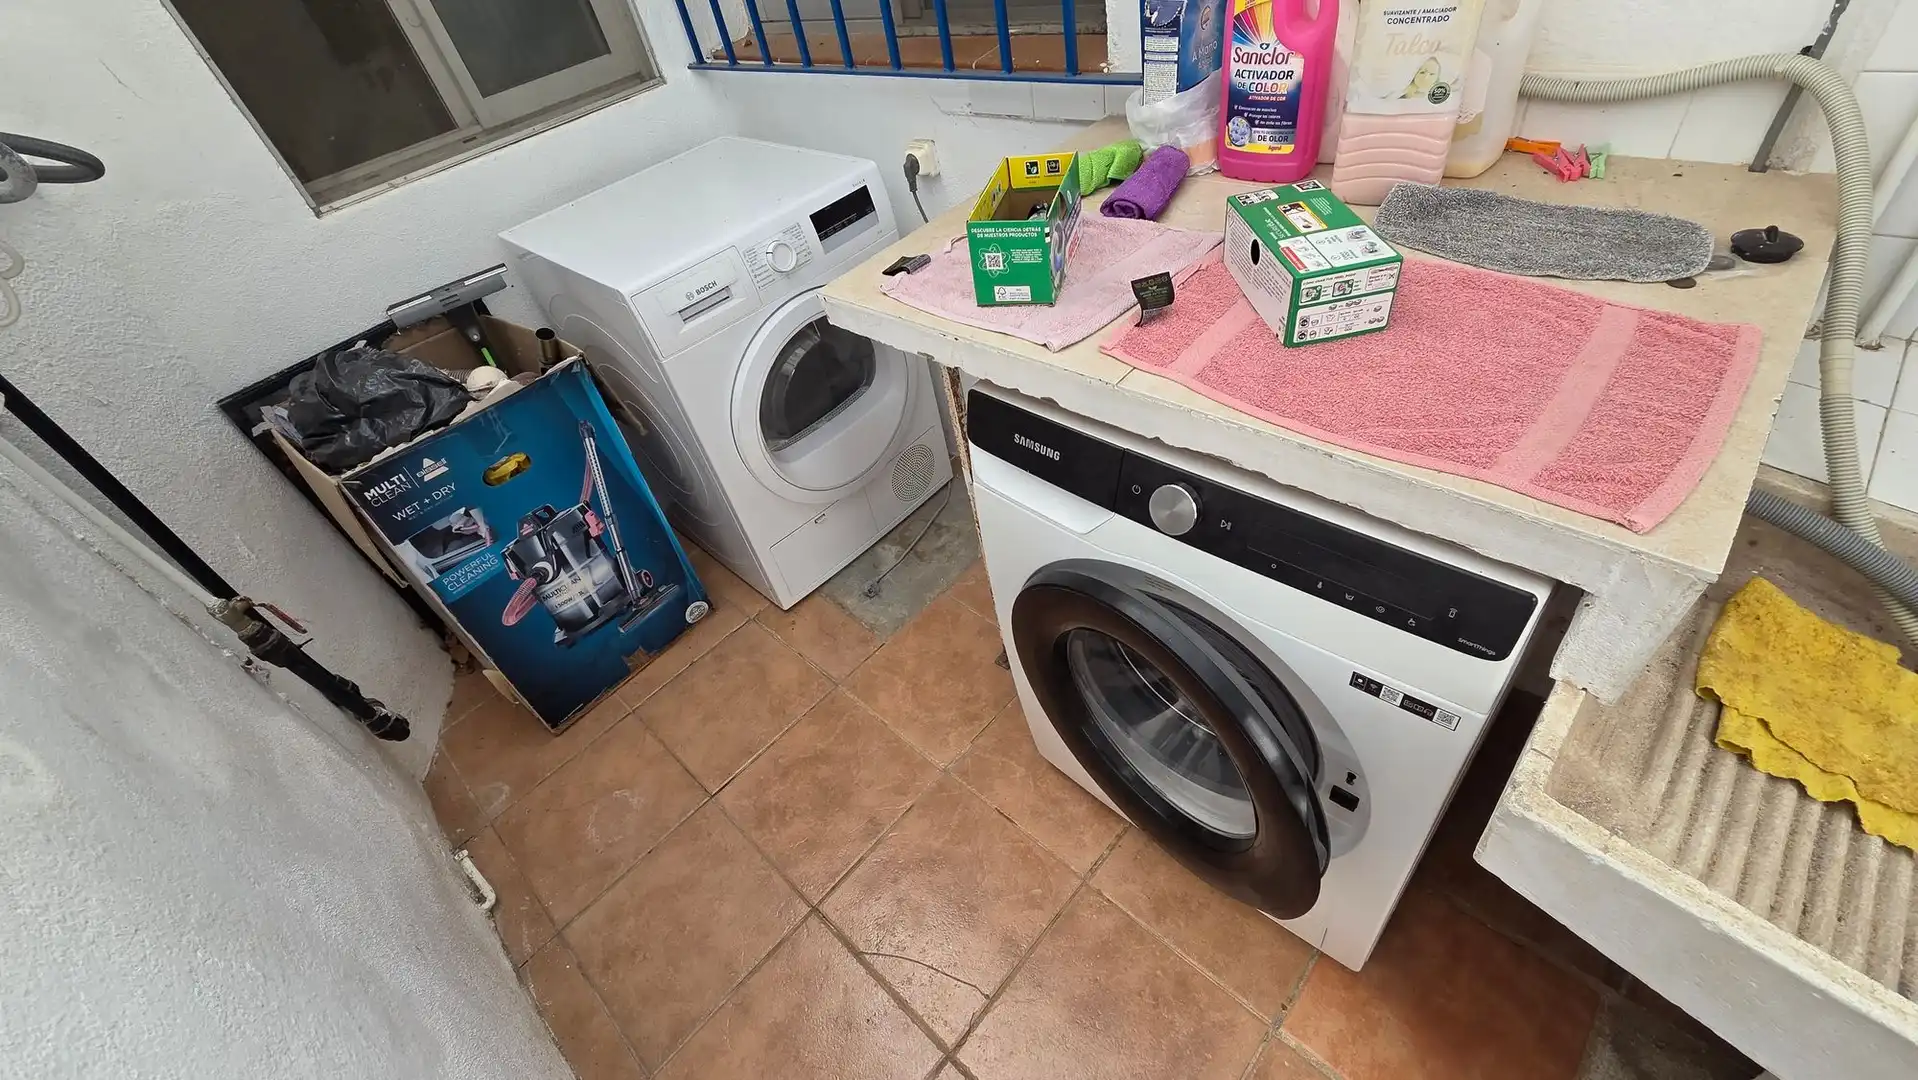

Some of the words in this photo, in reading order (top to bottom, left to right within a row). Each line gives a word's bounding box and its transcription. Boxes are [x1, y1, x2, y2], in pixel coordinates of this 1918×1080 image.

[1422, 6, 1457, 14] AMACIADOR
[1387, 15, 1450, 25] CONCENTRADO
[1232, 46, 1294, 65] Saniclor
[1234, 69, 1294, 80] ACTIVADOR
[1248, 82, 1289, 94] COLOR
[1257, 134, 1268, 142] DE
[1269, 135, 1289, 143] OLOR
[695, 280, 718, 296] BOSCH
[1013, 433, 1061, 461] SAMSUNG
[363, 473, 407, 501] MULTI
[370, 481, 413, 508] CLEAN
[392, 501, 421, 522] WET
[432, 482, 457, 501] DRY
[443, 551, 495, 586] POWERFUL
[447, 556, 499, 592] CLEANING
